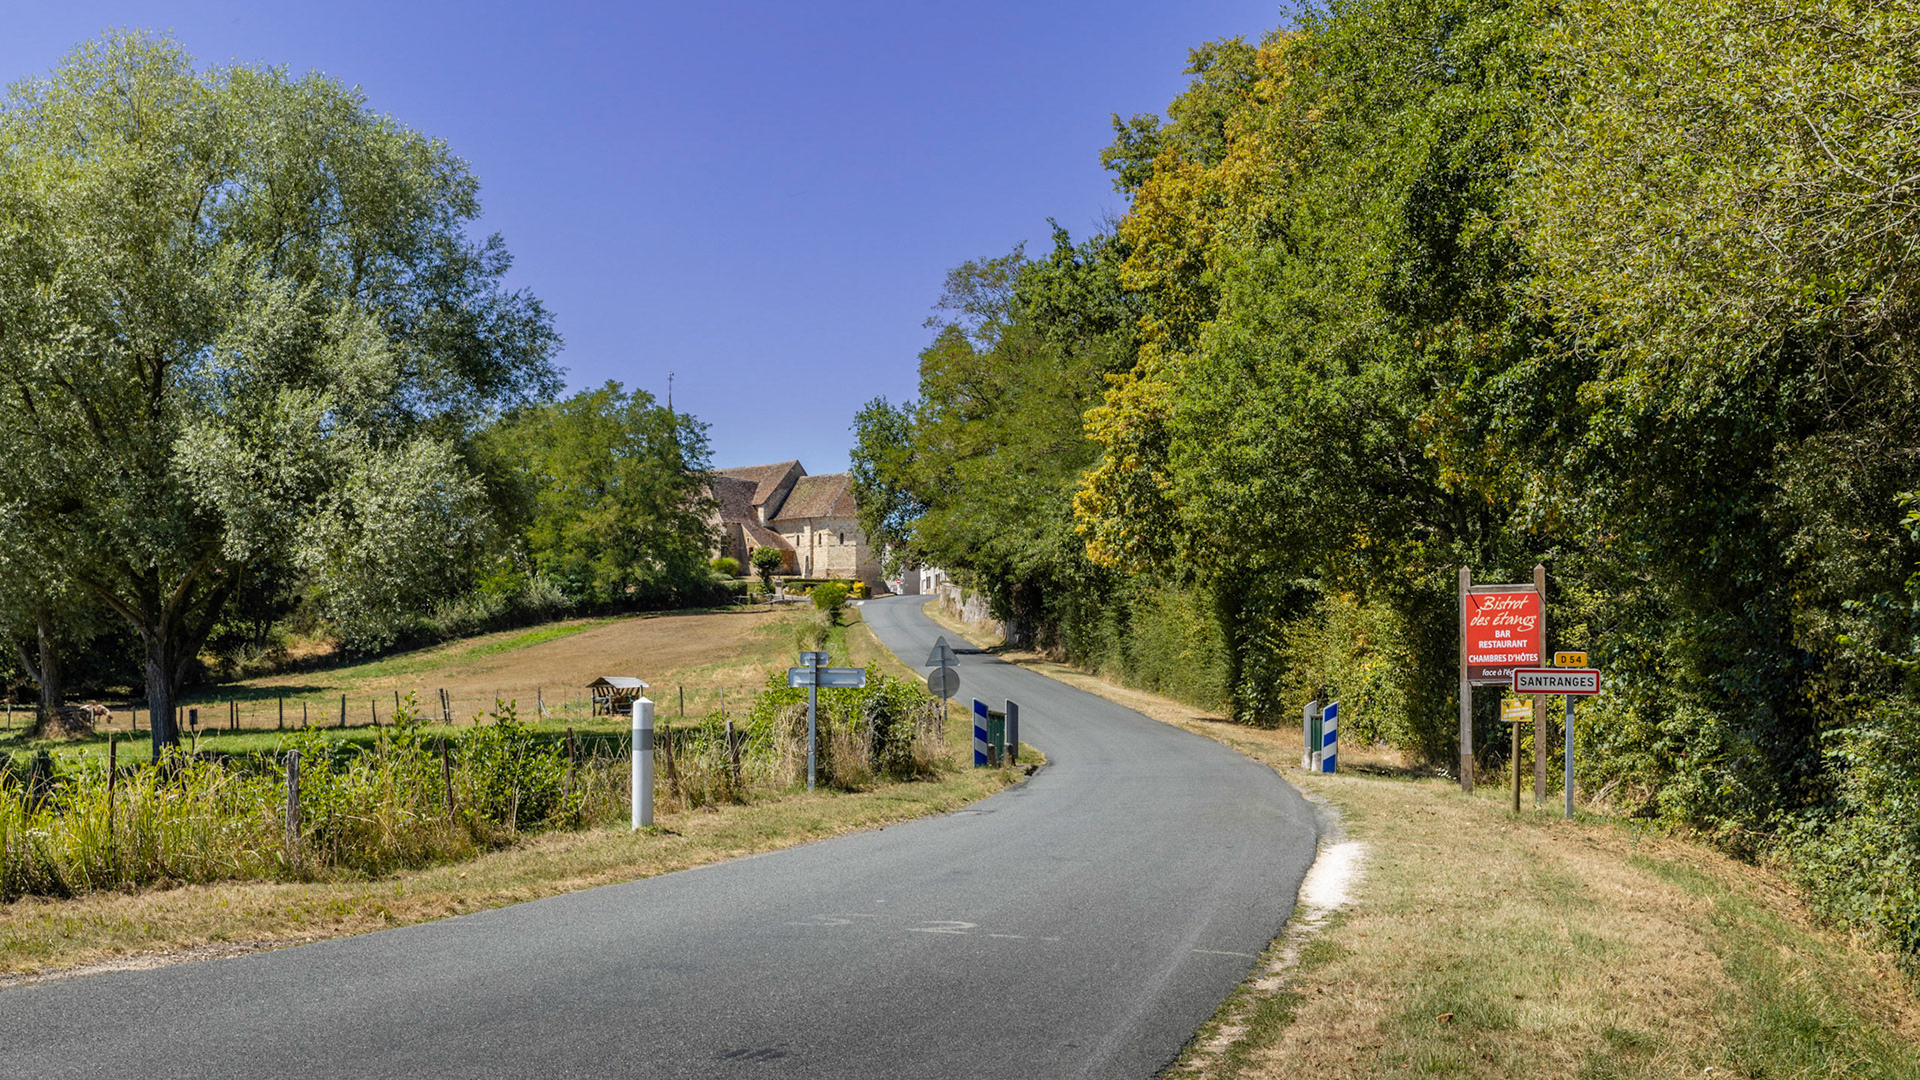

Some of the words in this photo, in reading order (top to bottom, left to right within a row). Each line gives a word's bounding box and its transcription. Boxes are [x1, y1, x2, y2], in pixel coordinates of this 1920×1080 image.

[1479, 595, 1529, 611] Bistrot
[1470, 608, 1491, 626] des
[1492, 611, 1537, 632] étangs
[1494, 629, 1511, 638] BAR
[1478, 639, 1528, 649] RESTAURANT
[1468, 654, 1507, 663] CHAMBRES
[1508, 652, 1539, 663] D'HÔTES
[1561, 655, 1567, 664] D
[1569, 655, 1582, 664] 54
[1482, 668, 1497, 677] face
[1520, 676, 1594, 687] SANTRANGES
